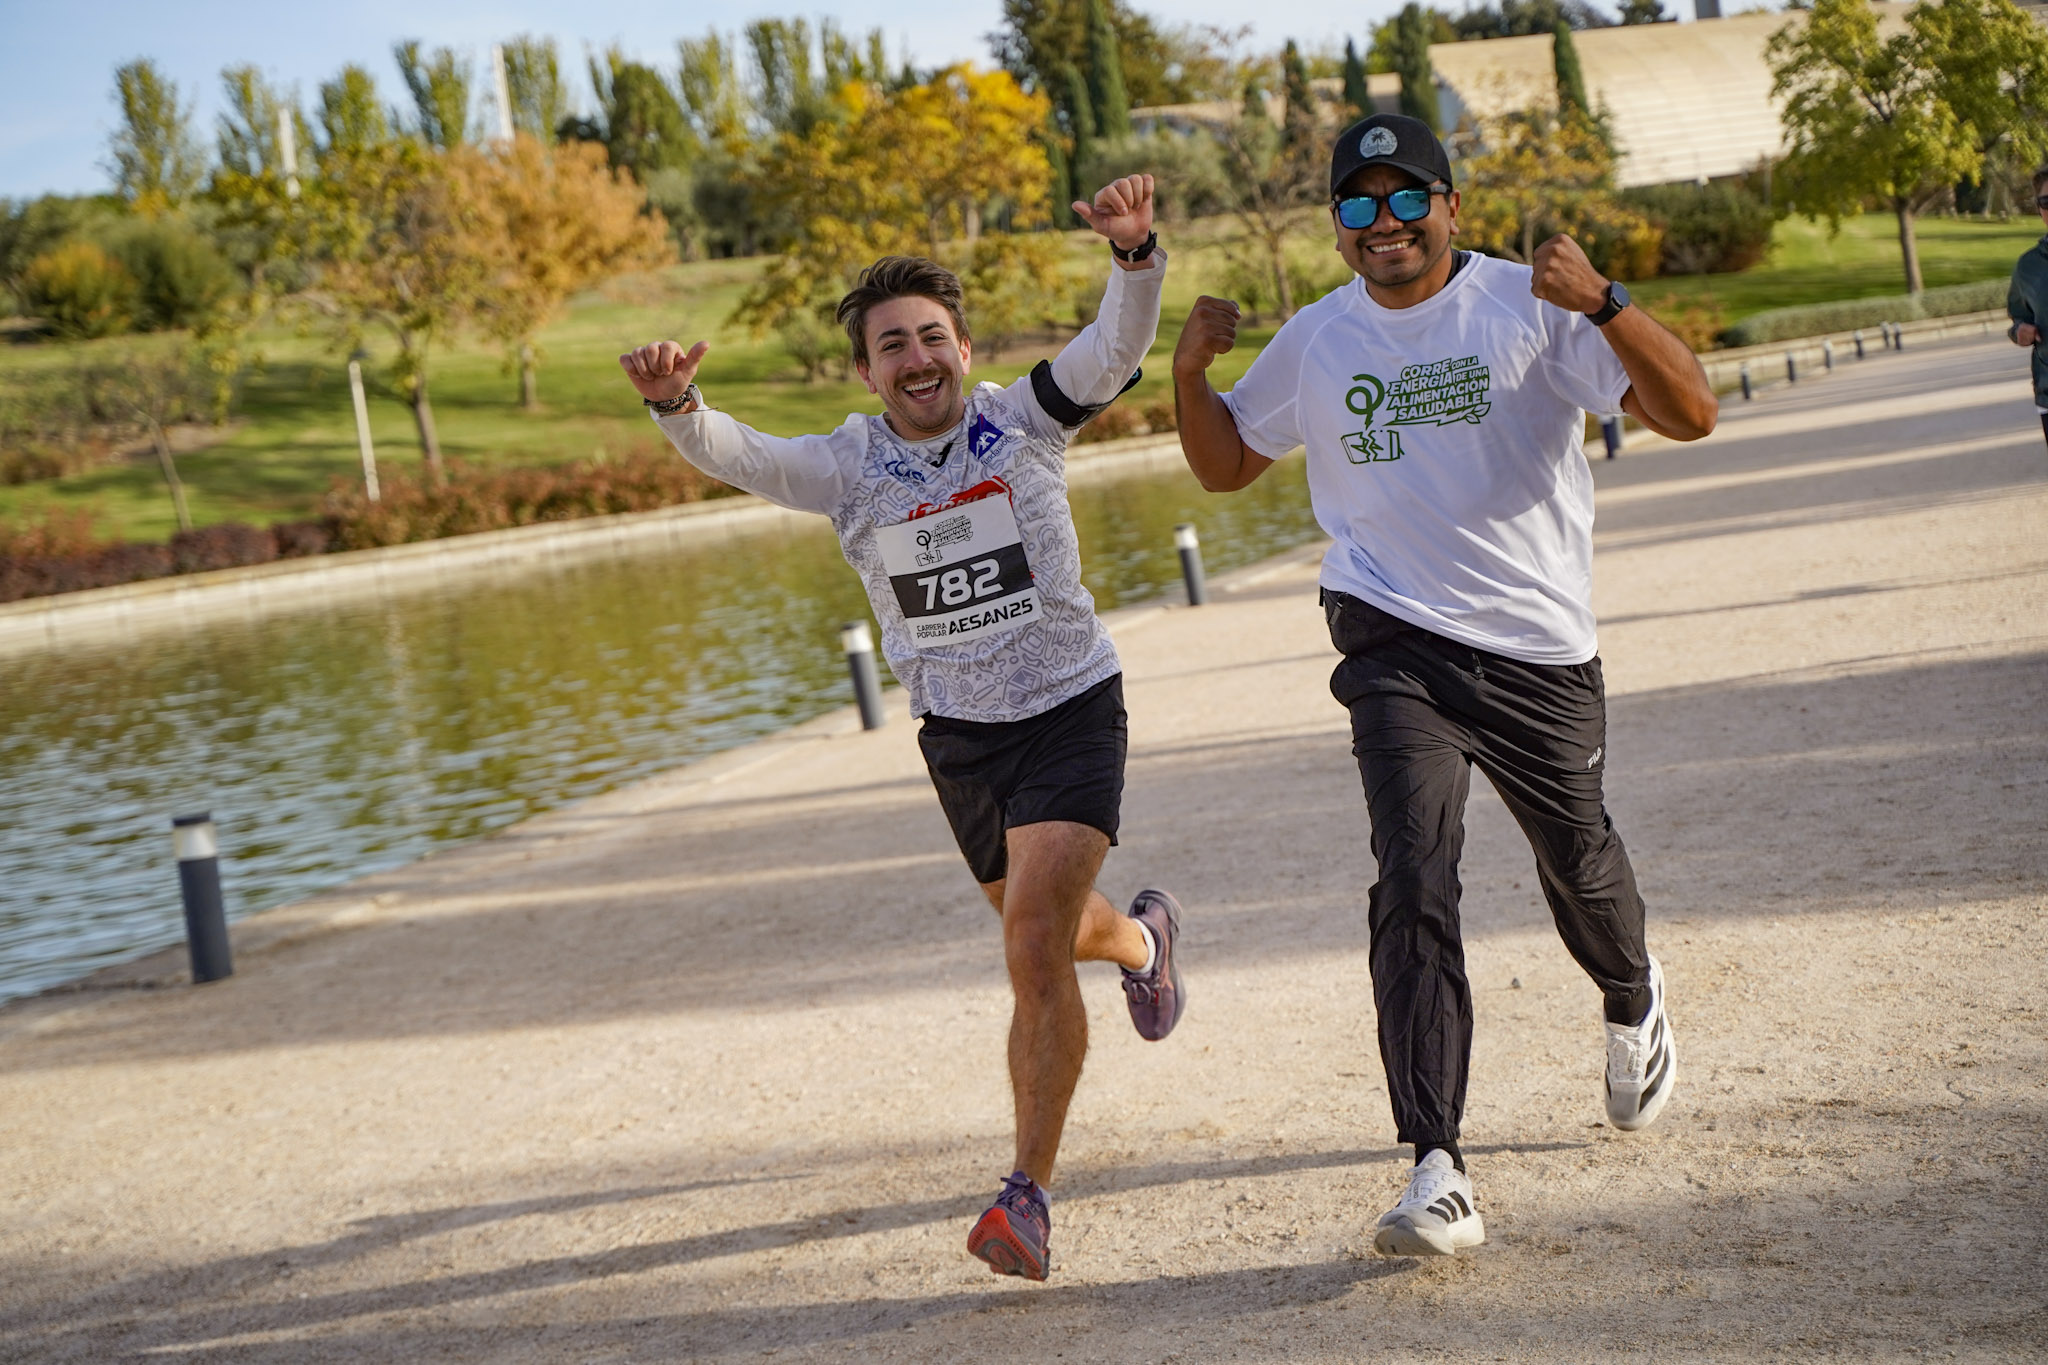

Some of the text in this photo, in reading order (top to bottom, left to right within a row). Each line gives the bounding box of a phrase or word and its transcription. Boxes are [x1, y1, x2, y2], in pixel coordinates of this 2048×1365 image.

[1401, 357, 1478, 380] CORRE CON LA
[1456, 372, 1467, 382] DE
[1469, 367, 1488, 379] UNA
[1389, 377, 1489, 408] ALIMENTACIÓN
[1398, 392, 1481, 420] SALUDABLE
[976, 431, 998, 460] AXA
[981, 435, 1011, 467] fundación
[916, 558, 1004, 610] 782
[917, 622, 947, 632] CARRERA
[917, 630, 947, 639] POPULAR
